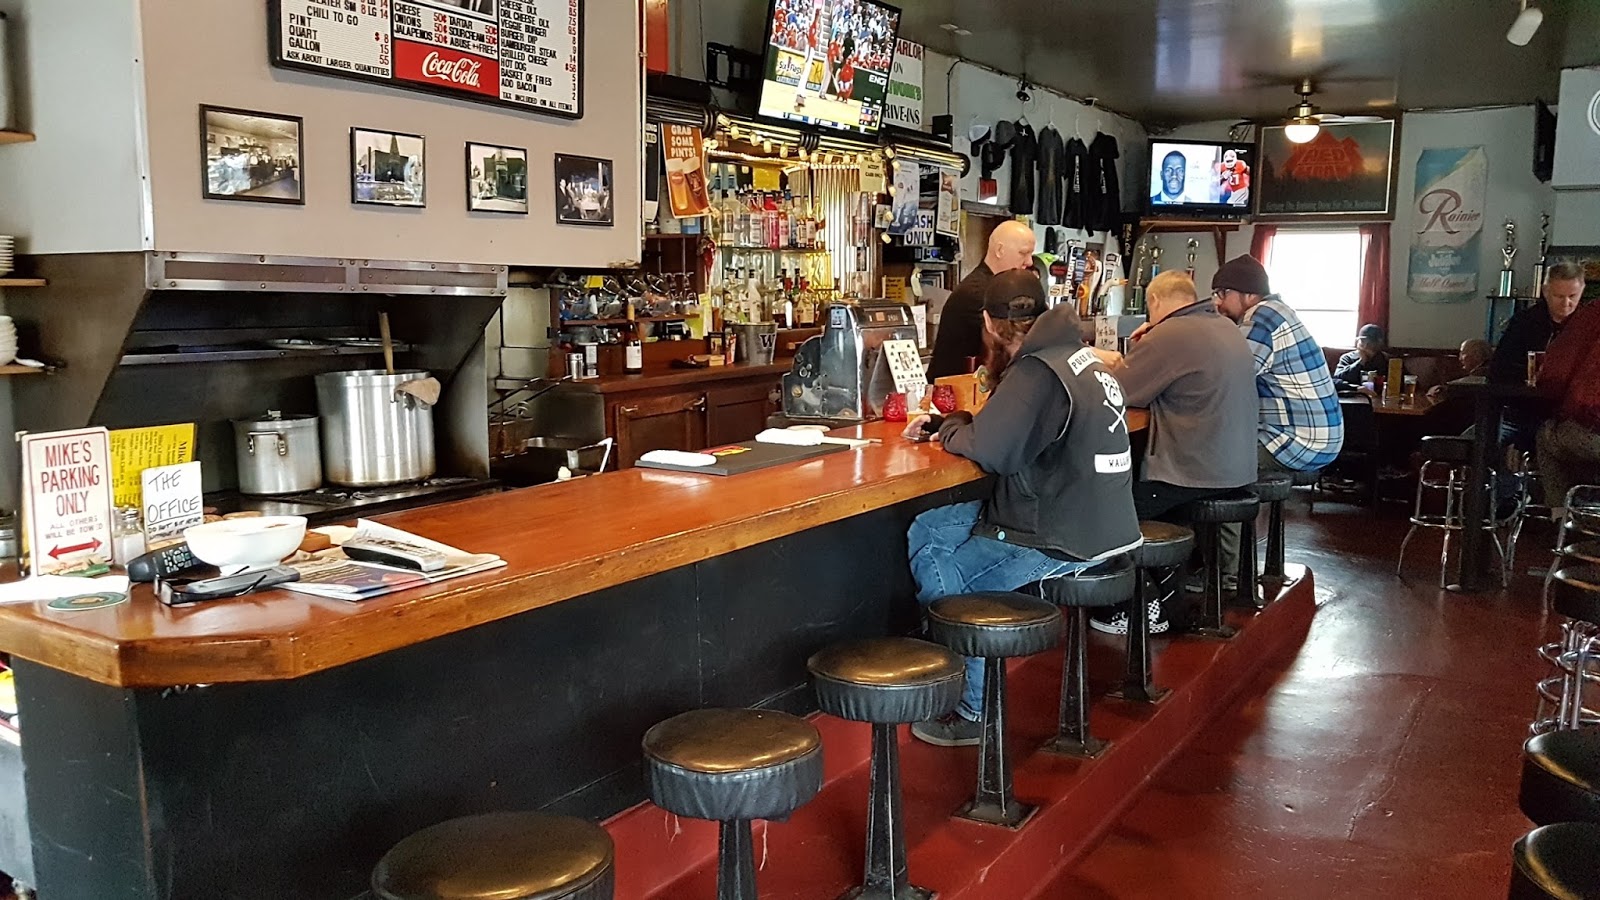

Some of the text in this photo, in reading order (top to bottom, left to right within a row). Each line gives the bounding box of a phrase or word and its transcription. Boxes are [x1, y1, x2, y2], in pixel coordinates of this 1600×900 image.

[361, 4, 366, 14] 8
[368, 6, 377, 16] LG
[381, 9, 388, 19] 14
[395, 3, 420, 17] CHEESE
[500, 0, 522, 12] CHEESE
[307, 6, 358, 26] CHILI TO GO
[395, 14, 421, 27] ONIONS
[449, 16, 472, 29] TARTAR
[514, 12, 536, 25] CHEESE
[289, 13, 312, 27] PINT
[384, 34, 389, 43] 8
[395, 24, 432, 40] JALAPENOS
[501, 18, 522, 31] VEGGIE
[525, 24, 546, 37] BURGER
[501, 29, 524, 41] BURGER
[528, 35, 538, 44] DIP
[289, 25, 389, 54] QUART 15
[450, 37, 470, 49] ABUSE
[501, 38, 536, 54] HAMBURGER
[539, 47, 557, 59] STEAK
[289, 37, 389, 65] GALLON 55
[501, 48, 525, 61] GRILLED
[528, 55, 548, 67] CHEESE
[896, 40, 922, 61] ARLOR
[286, 50, 389, 76] ASK ABOUT LARGER QUANTITIES
[422, 51, 482, 86] Coca-Cola
[501, 58, 513, 68] HOT
[515, 61, 526, 71] DOG
[501, 68, 523, 80] BASKET
[526, 73, 533, 82] OF
[536, 75, 552, 86] FRIES
[501, 78, 514, 88] ADD
[517, 81, 537, 93] BACON
[515, 94, 537, 104] INCLUDED
[558, 103, 572, 111] ITEMS
[884, 103, 919, 125] RIVE-INS
[671, 125, 692, 135] GRAB
[671, 136, 693, 147] SOME
[671, 147, 696, 157] PINTS!
[1416, 188, 1480, 234] Rainier
[914, 215, 933, 229] ASH
[906, 231, 932, 245] ONLY
[44, 441, 92, 468] MIKE'S
[40, 465, 100, 494] PARKING
[148, 469, 181, 493] THE
[56, 490, 89, 517] ONLY
[148, 496, 200, 523] OFFICE
